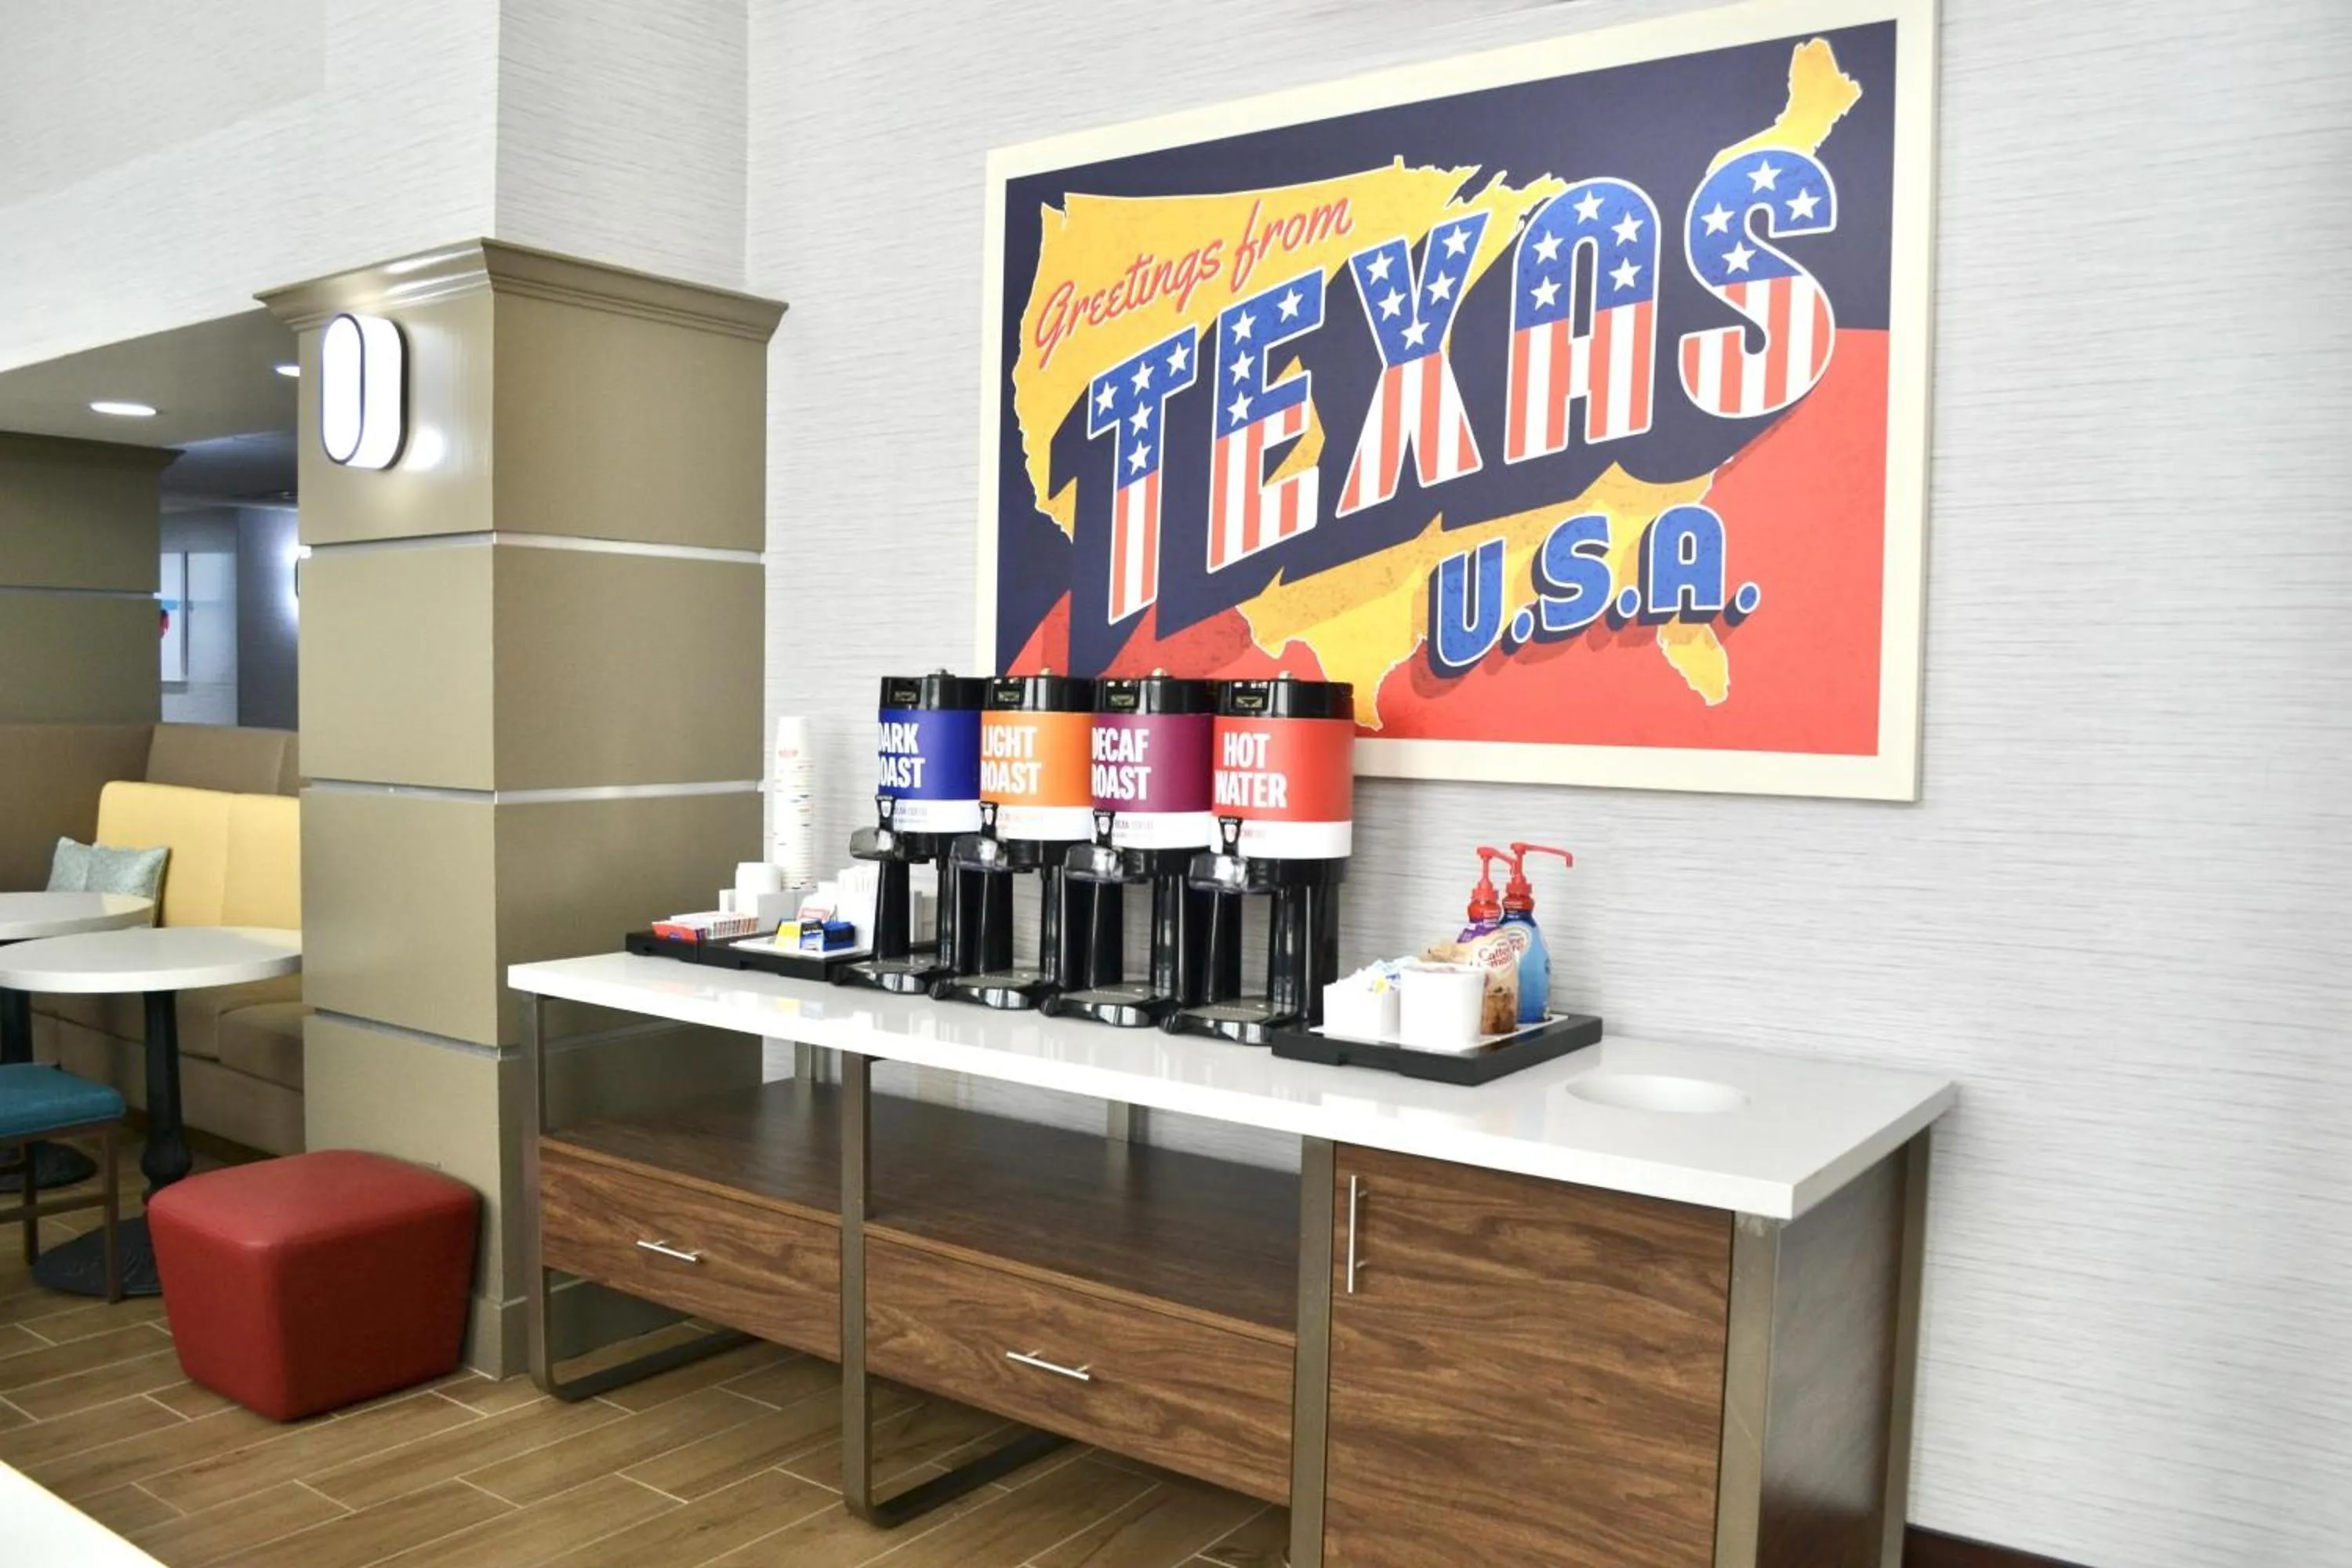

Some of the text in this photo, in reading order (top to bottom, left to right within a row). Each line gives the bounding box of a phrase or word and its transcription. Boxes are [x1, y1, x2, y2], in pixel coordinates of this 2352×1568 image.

[1035, 198, 1353, 369] Greetings from
[1087, 148, 1837, 625] TEXAS
[1436, 504, 1761, 668] U.S.A.
[878, 756, 926, 789] OAST
[982, 724, 1038, 759] LIGHT
[1223, 731, 1271, 769] HOT
